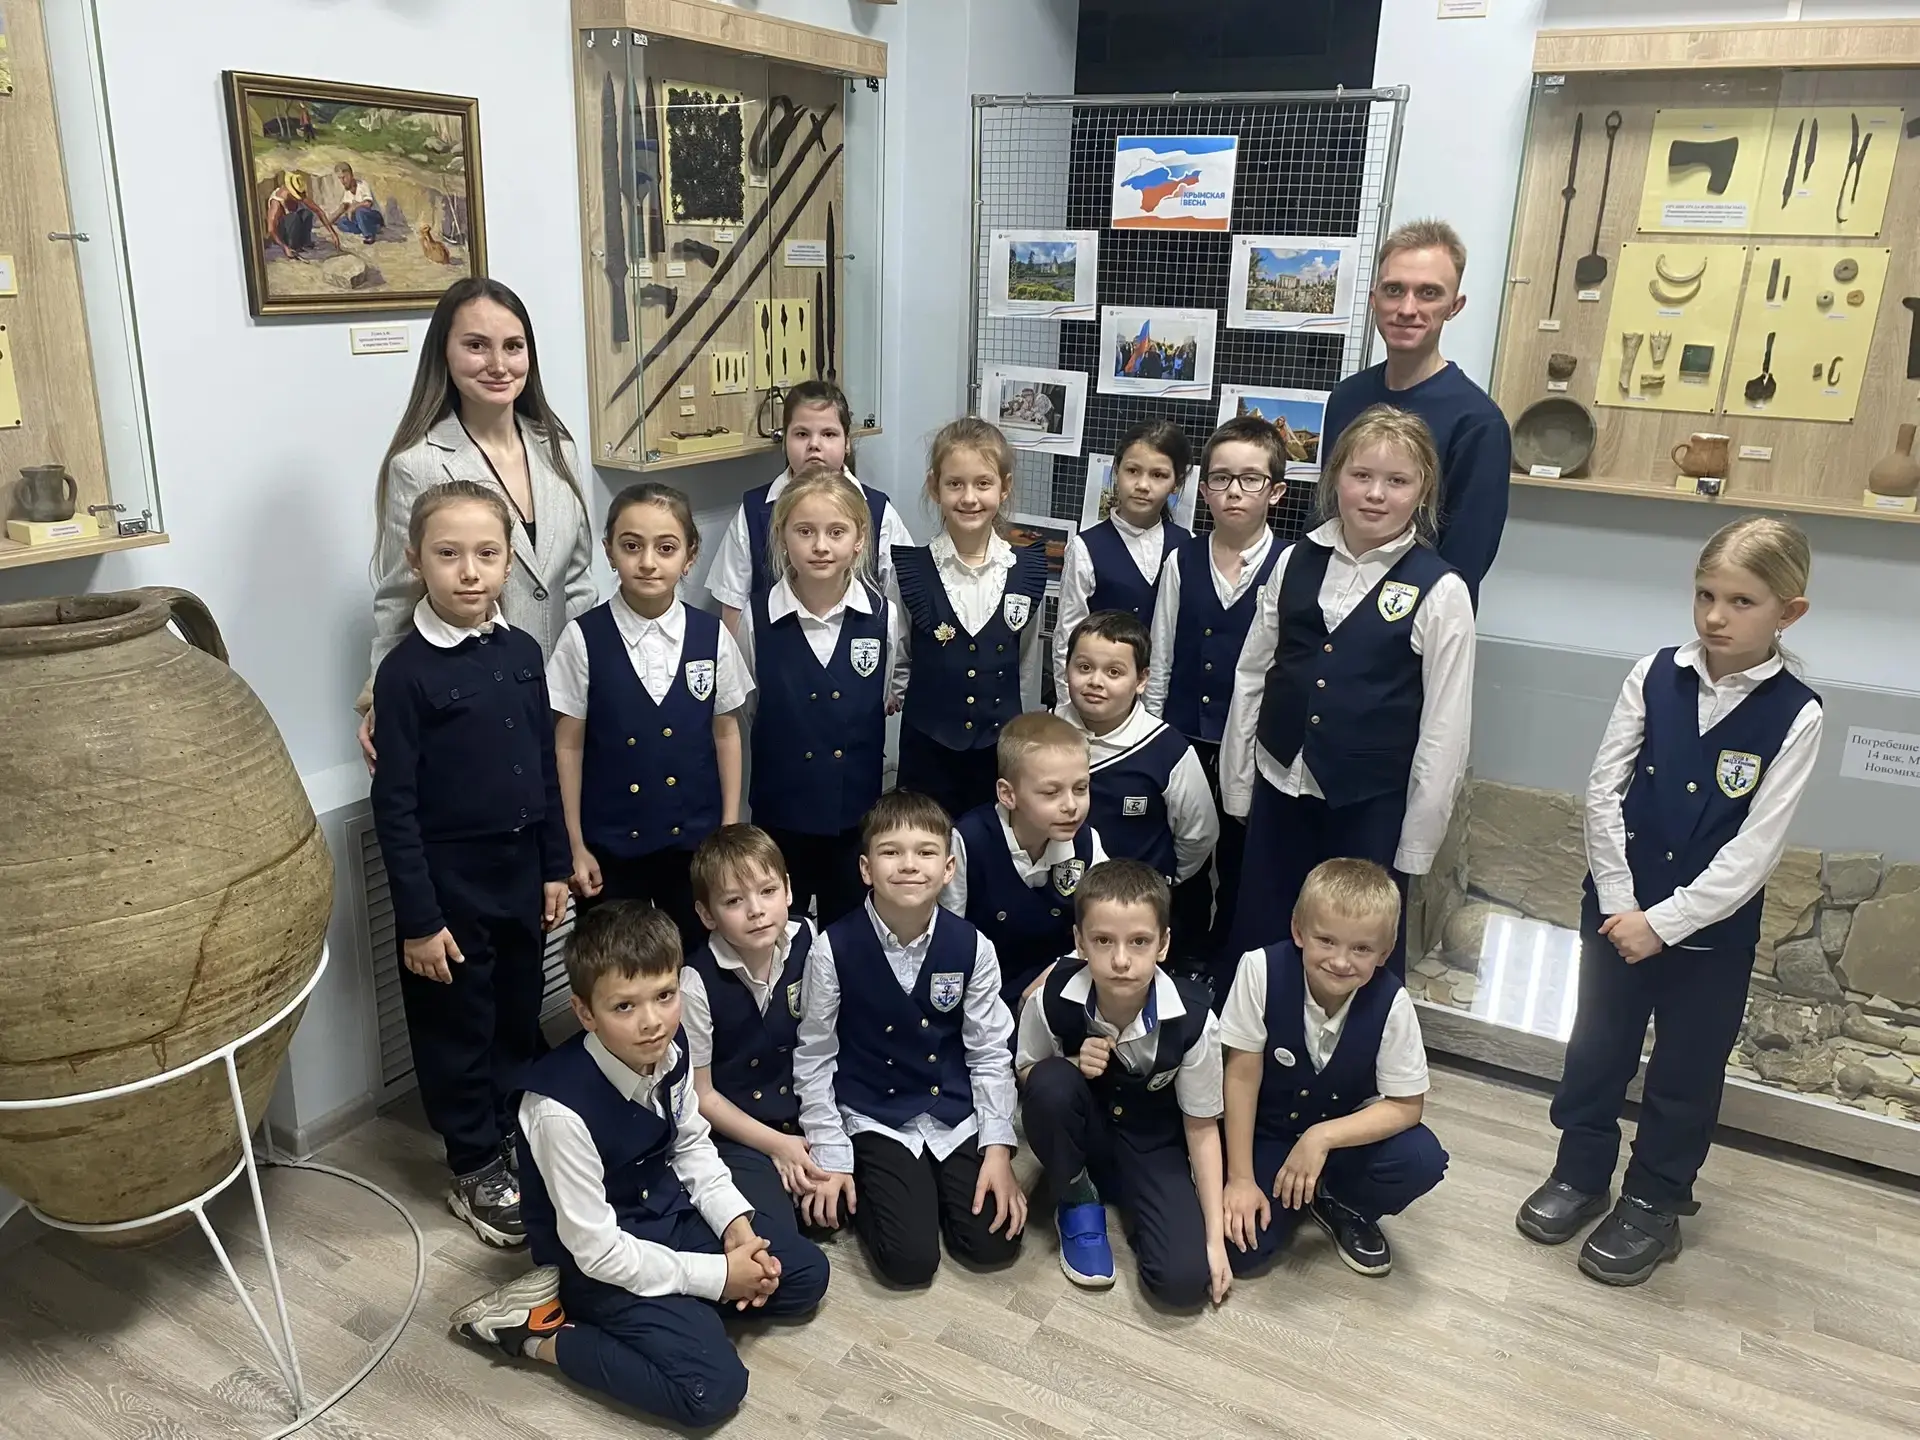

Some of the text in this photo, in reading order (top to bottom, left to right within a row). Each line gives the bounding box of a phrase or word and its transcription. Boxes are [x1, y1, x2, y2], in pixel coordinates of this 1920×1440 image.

[1183, 191, 1225, 199] КРЫМСКАЯ
[1852, 734, 1919, 751] Погребение
[1867, 749, 1880, 759] 14
[1882, 753, 1905, 763] век.
